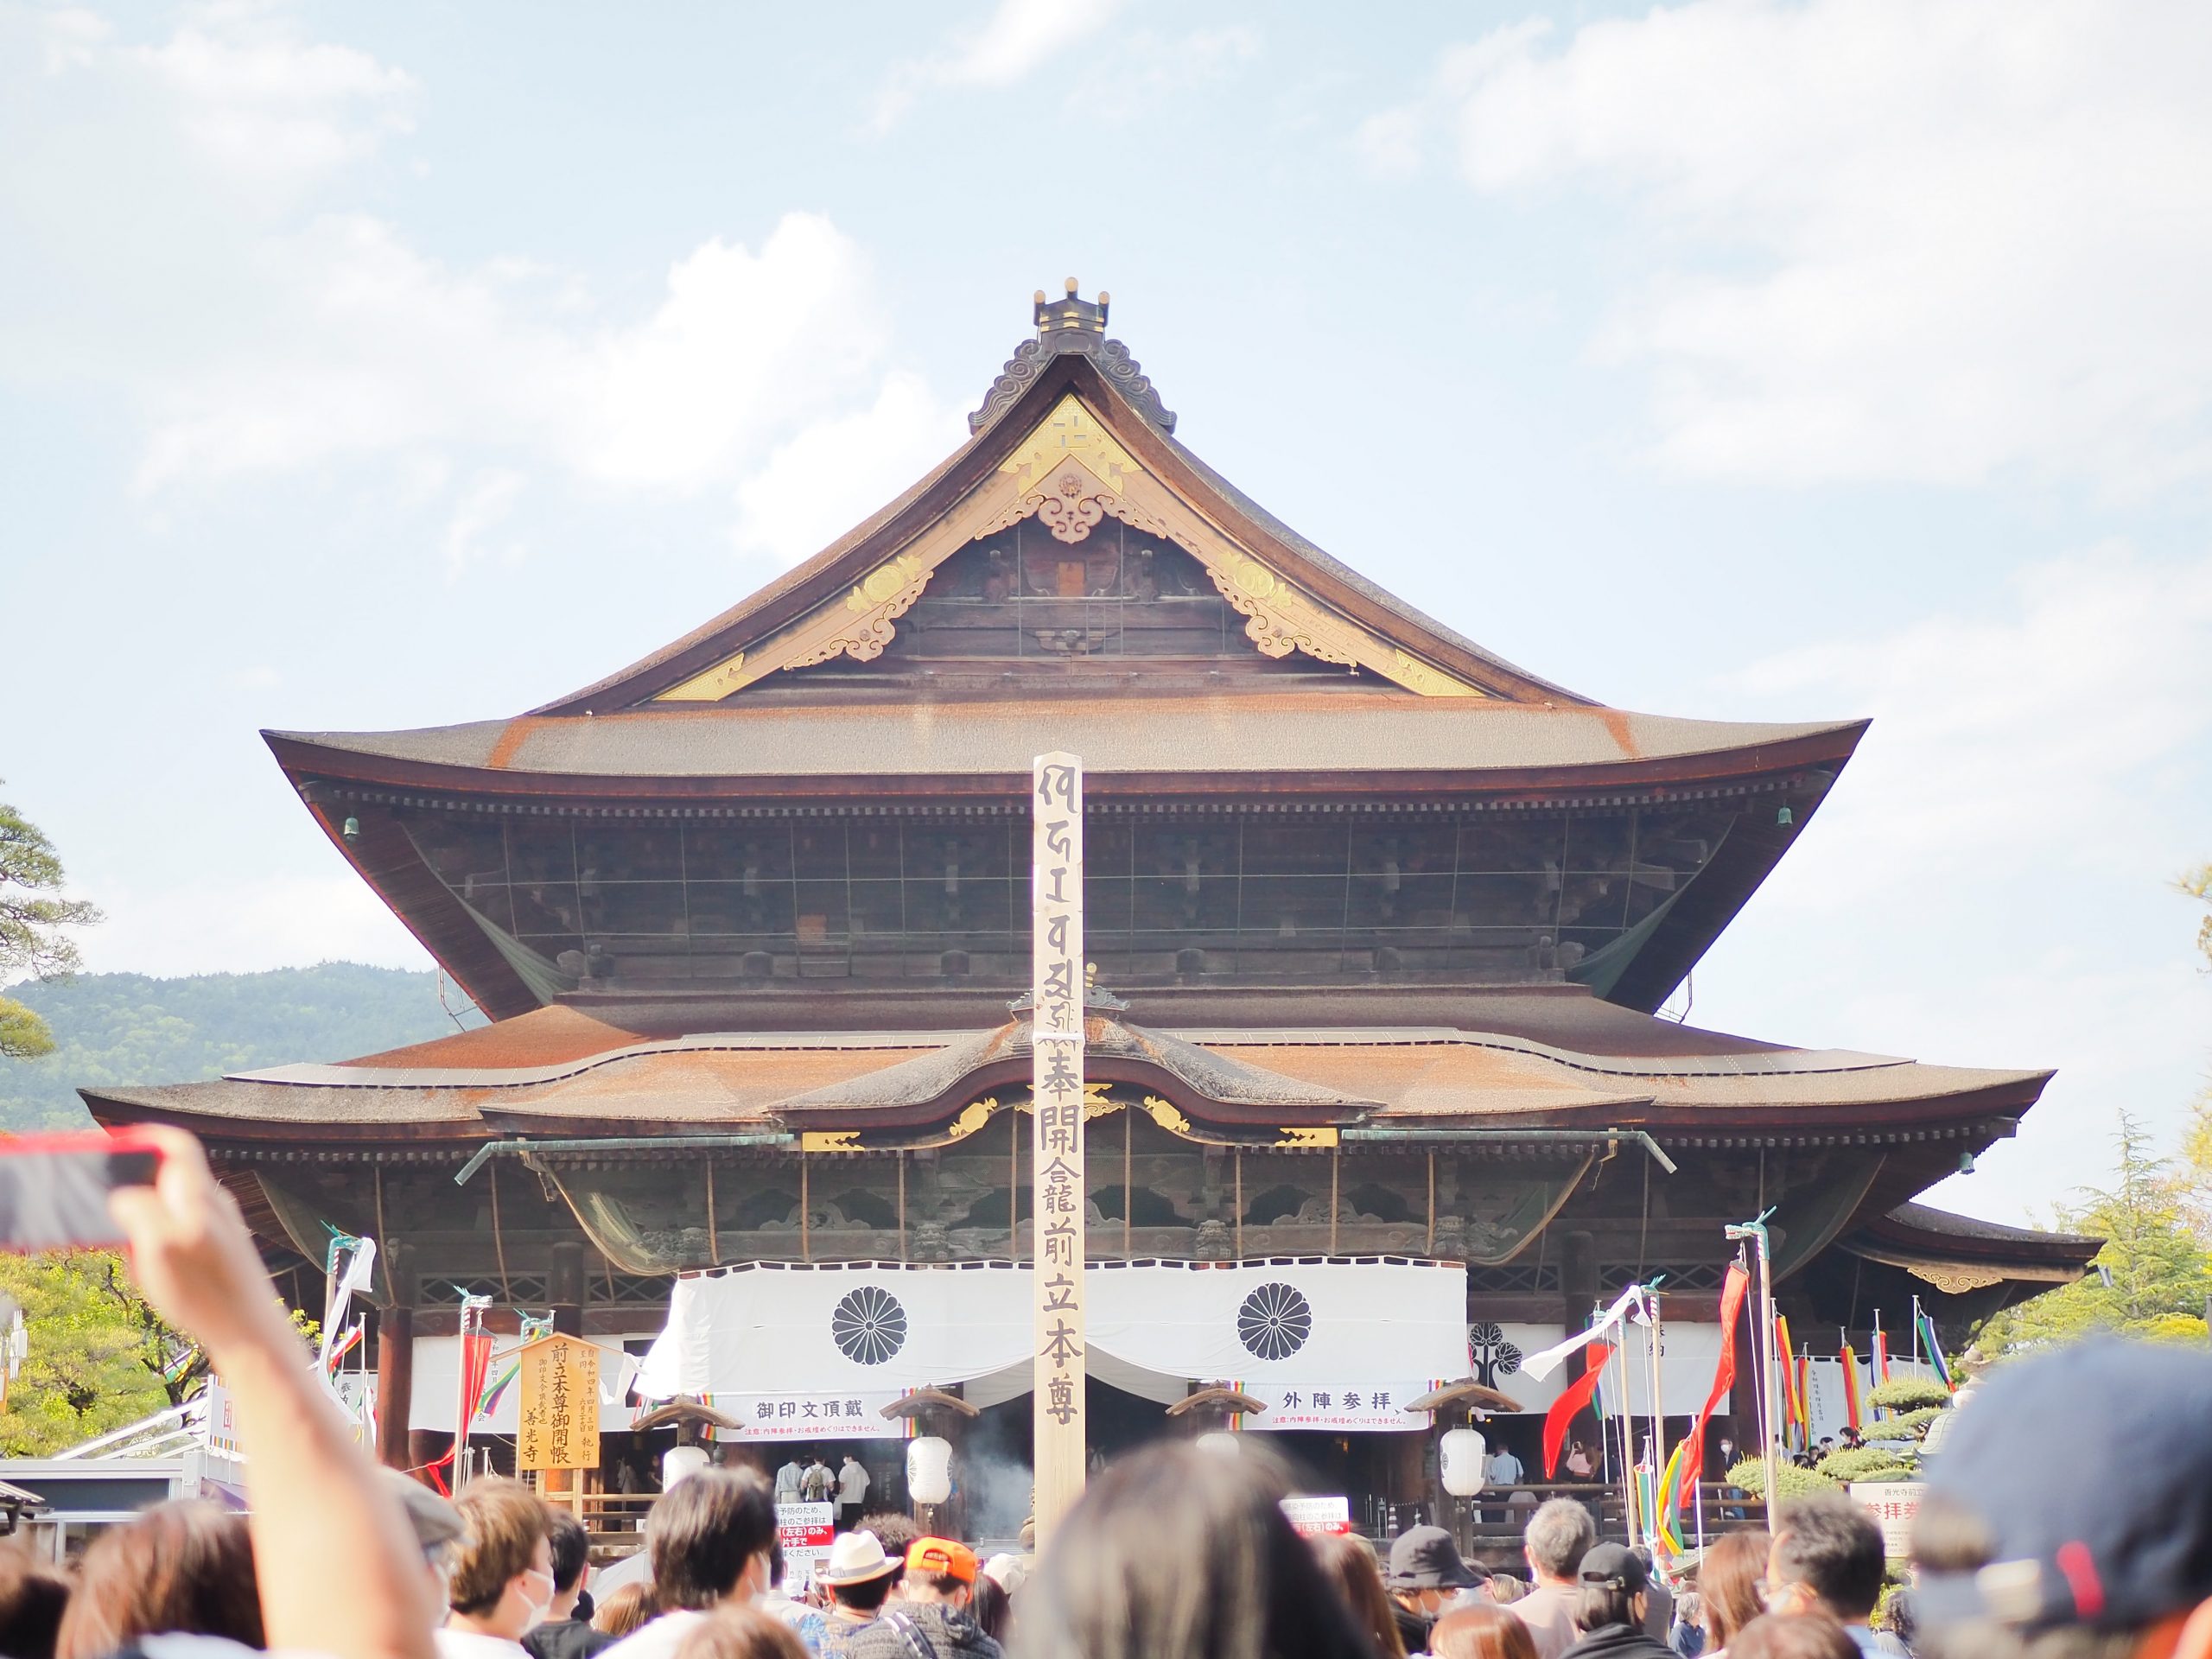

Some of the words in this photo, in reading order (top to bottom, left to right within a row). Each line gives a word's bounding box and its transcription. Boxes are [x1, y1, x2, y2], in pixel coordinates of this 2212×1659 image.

[550, 1342, 571, 1465] 前立本尊御開帳
[756, 1399, 864, 1420] 御印文頂戴
[1283, 1391, 1393, 1410] 外陣参拝
[523, 1408, 539, 1463] 善光寺
[782, 1538, 808, 1547] 片手で
